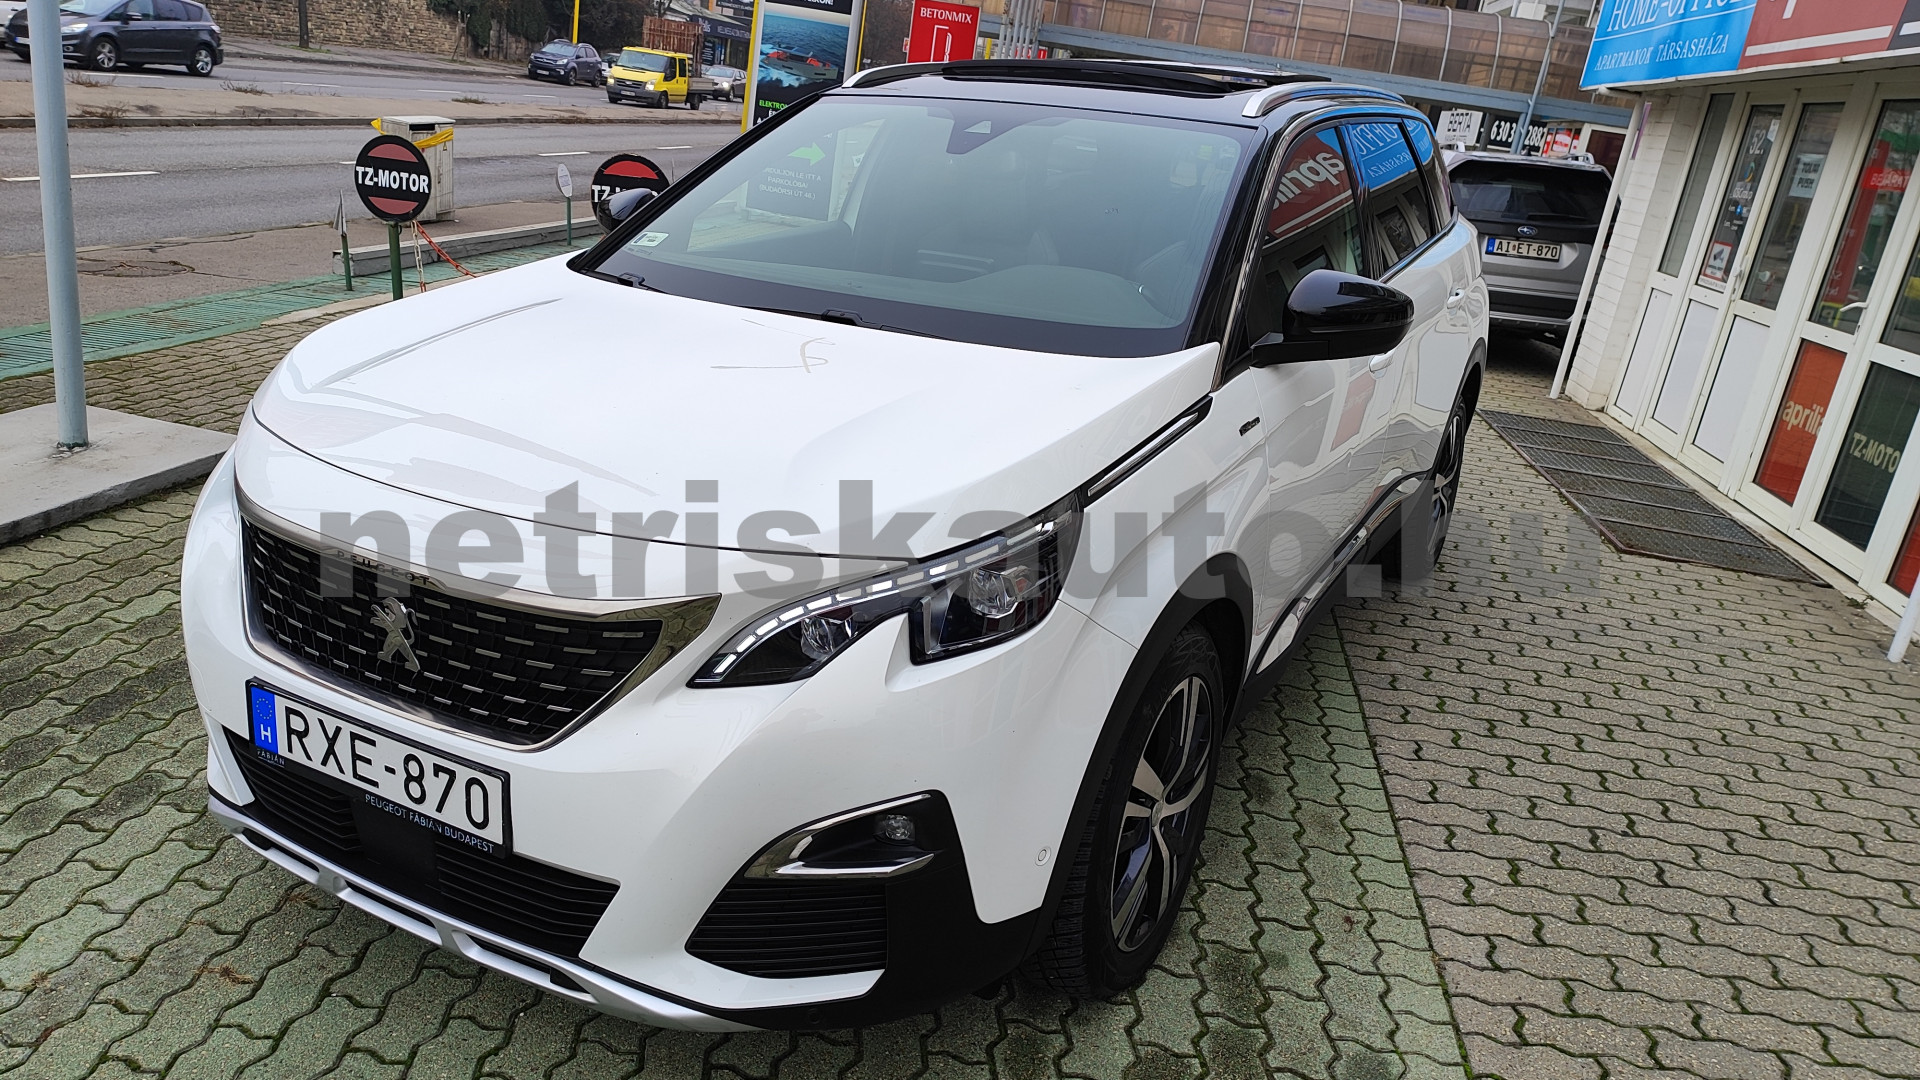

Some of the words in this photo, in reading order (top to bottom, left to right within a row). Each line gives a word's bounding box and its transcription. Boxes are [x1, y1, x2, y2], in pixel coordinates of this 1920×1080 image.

[920, 7, 973, 24] BETONMIX
[1594, 47, 1653, 71] APARTMANOK
[1656, 32, 1729, 62] TÁRSASHÁZA
[1447, 112, 1473, 132] BERTA
[356, 166, 429, 194] TZ-MOTOR
[1849, 432, 1900, 473] TZ-MOTO
[337, 550, 430, 585] PEUGEOT
[260, 724, 272, 743] H
[285, 706, 489, 830] RXE-870
[365, 793, 407, 819] PEUGEOT
[444, 826, 494, 853] BUDAPEST
